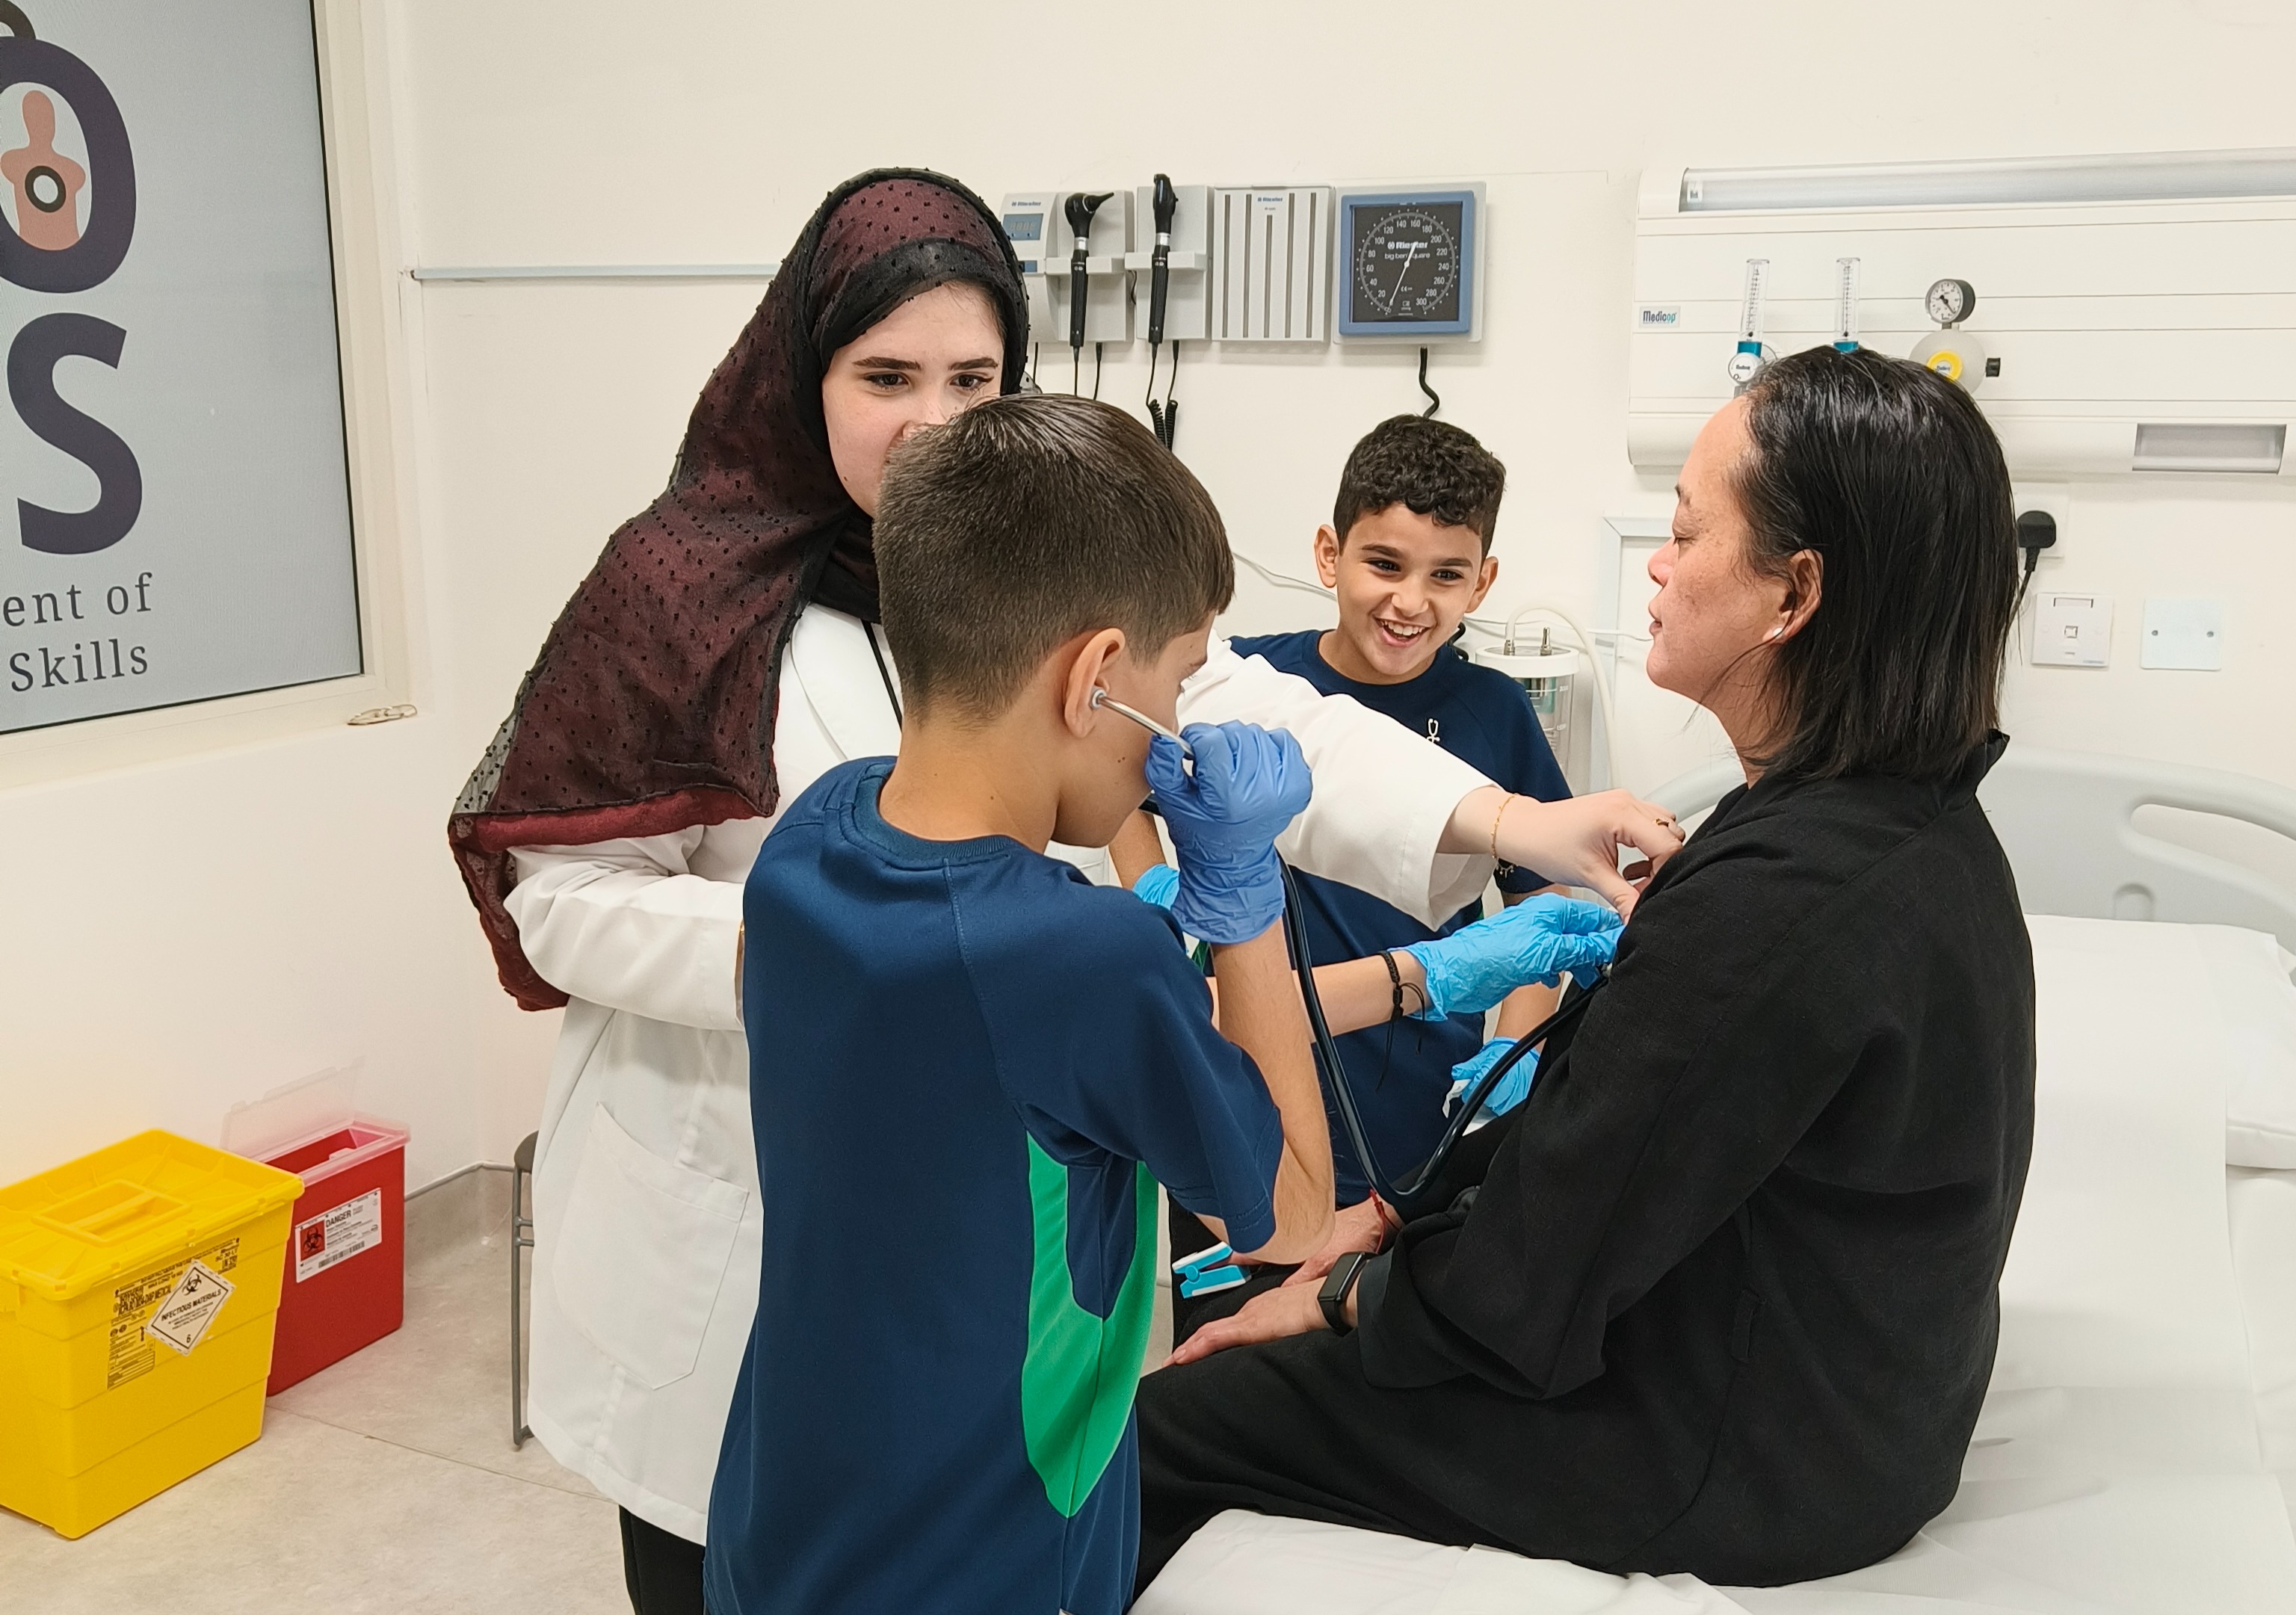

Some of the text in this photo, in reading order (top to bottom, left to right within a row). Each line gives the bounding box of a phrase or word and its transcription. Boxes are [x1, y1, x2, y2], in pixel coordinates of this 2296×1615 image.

[1396, 220, 1407, 228] 140
[1422, 225, 1433, 233] 180
[1368, 250, 1376, 258] 80
[1438, 262, 1449, 271] 240
[1434, 277, 1445, 285] 260
[1425, 288, 1437, 297] 280
[1416, 297, 1427, 306] 300
[7, 312, 143, 555] S
[3, 572, 152, 627] ent of
[10, 638, 148, 692] Skills
[325, 1210, 351, 1228] DANGER
[161, 1302, 192, 1321] INFECTIOUS
[193, 1288, 221, 1306] MATERIALS
[186, 1334, 191, 1343] 6
